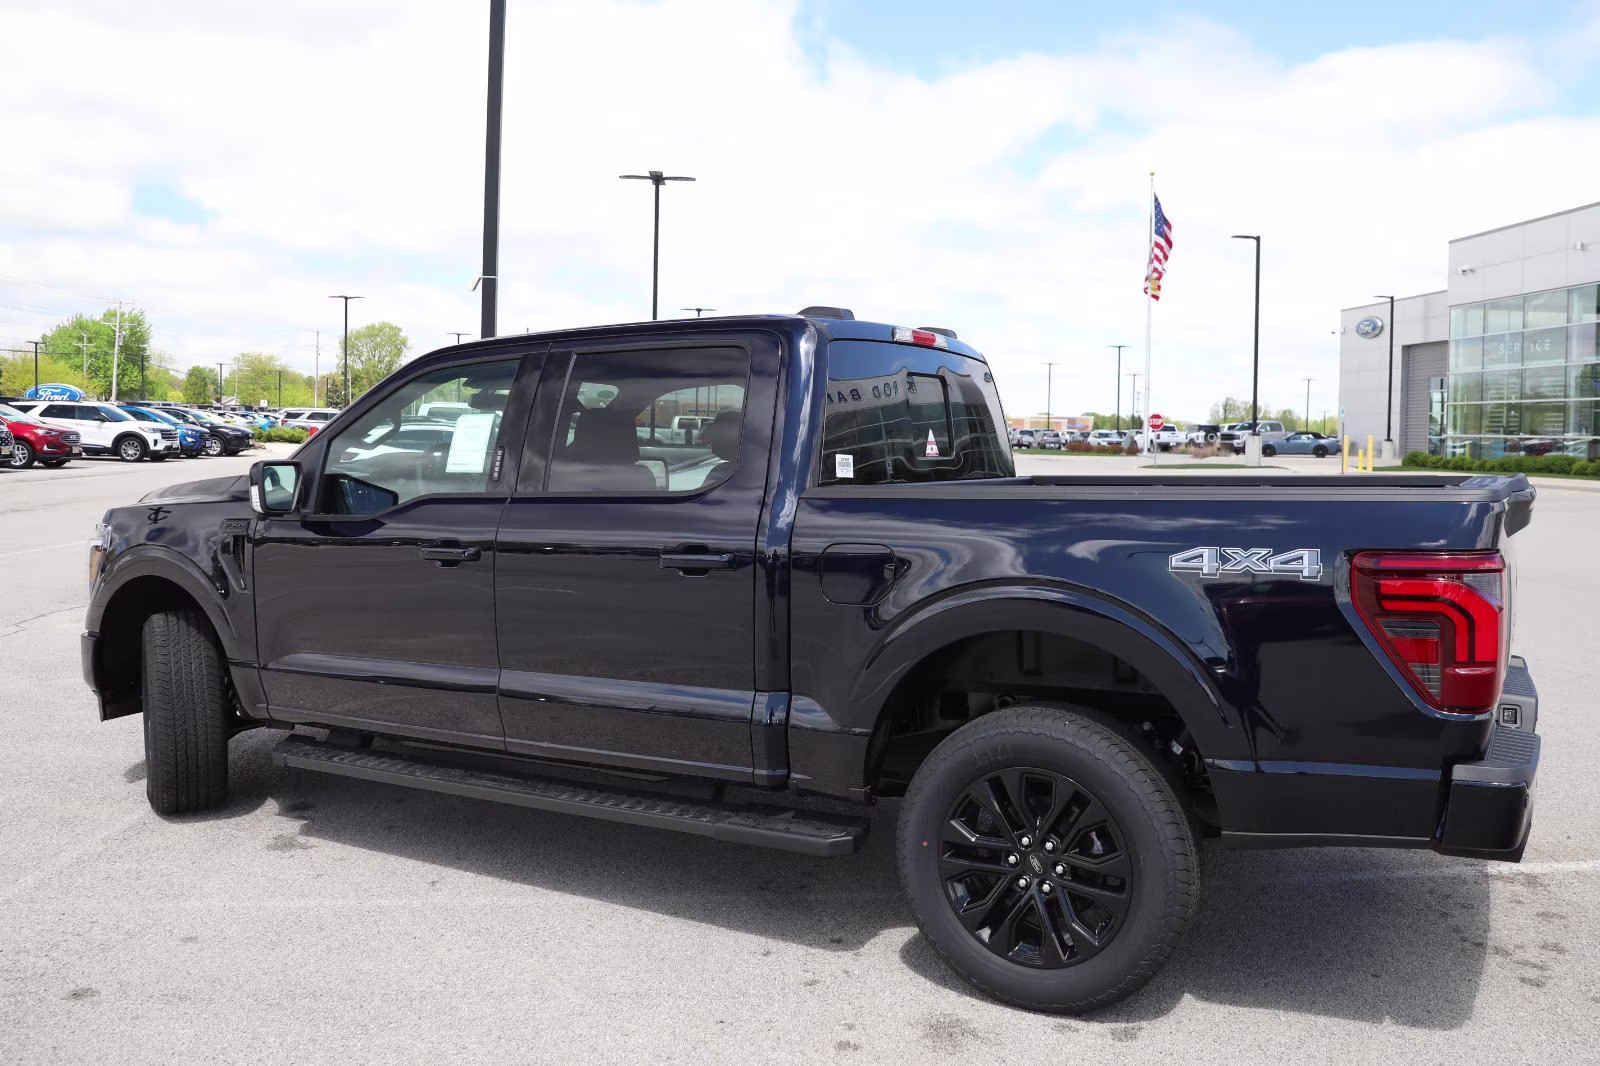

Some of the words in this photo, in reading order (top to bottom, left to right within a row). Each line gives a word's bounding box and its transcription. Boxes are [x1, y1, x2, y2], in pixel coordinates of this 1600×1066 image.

[1498, 339, 1551, 355] SERICE
[37, 388, 71, 401] Ford
[1148, 418, 1163, 426] STOP
[1168, 546, 1322, 581] 4X4
